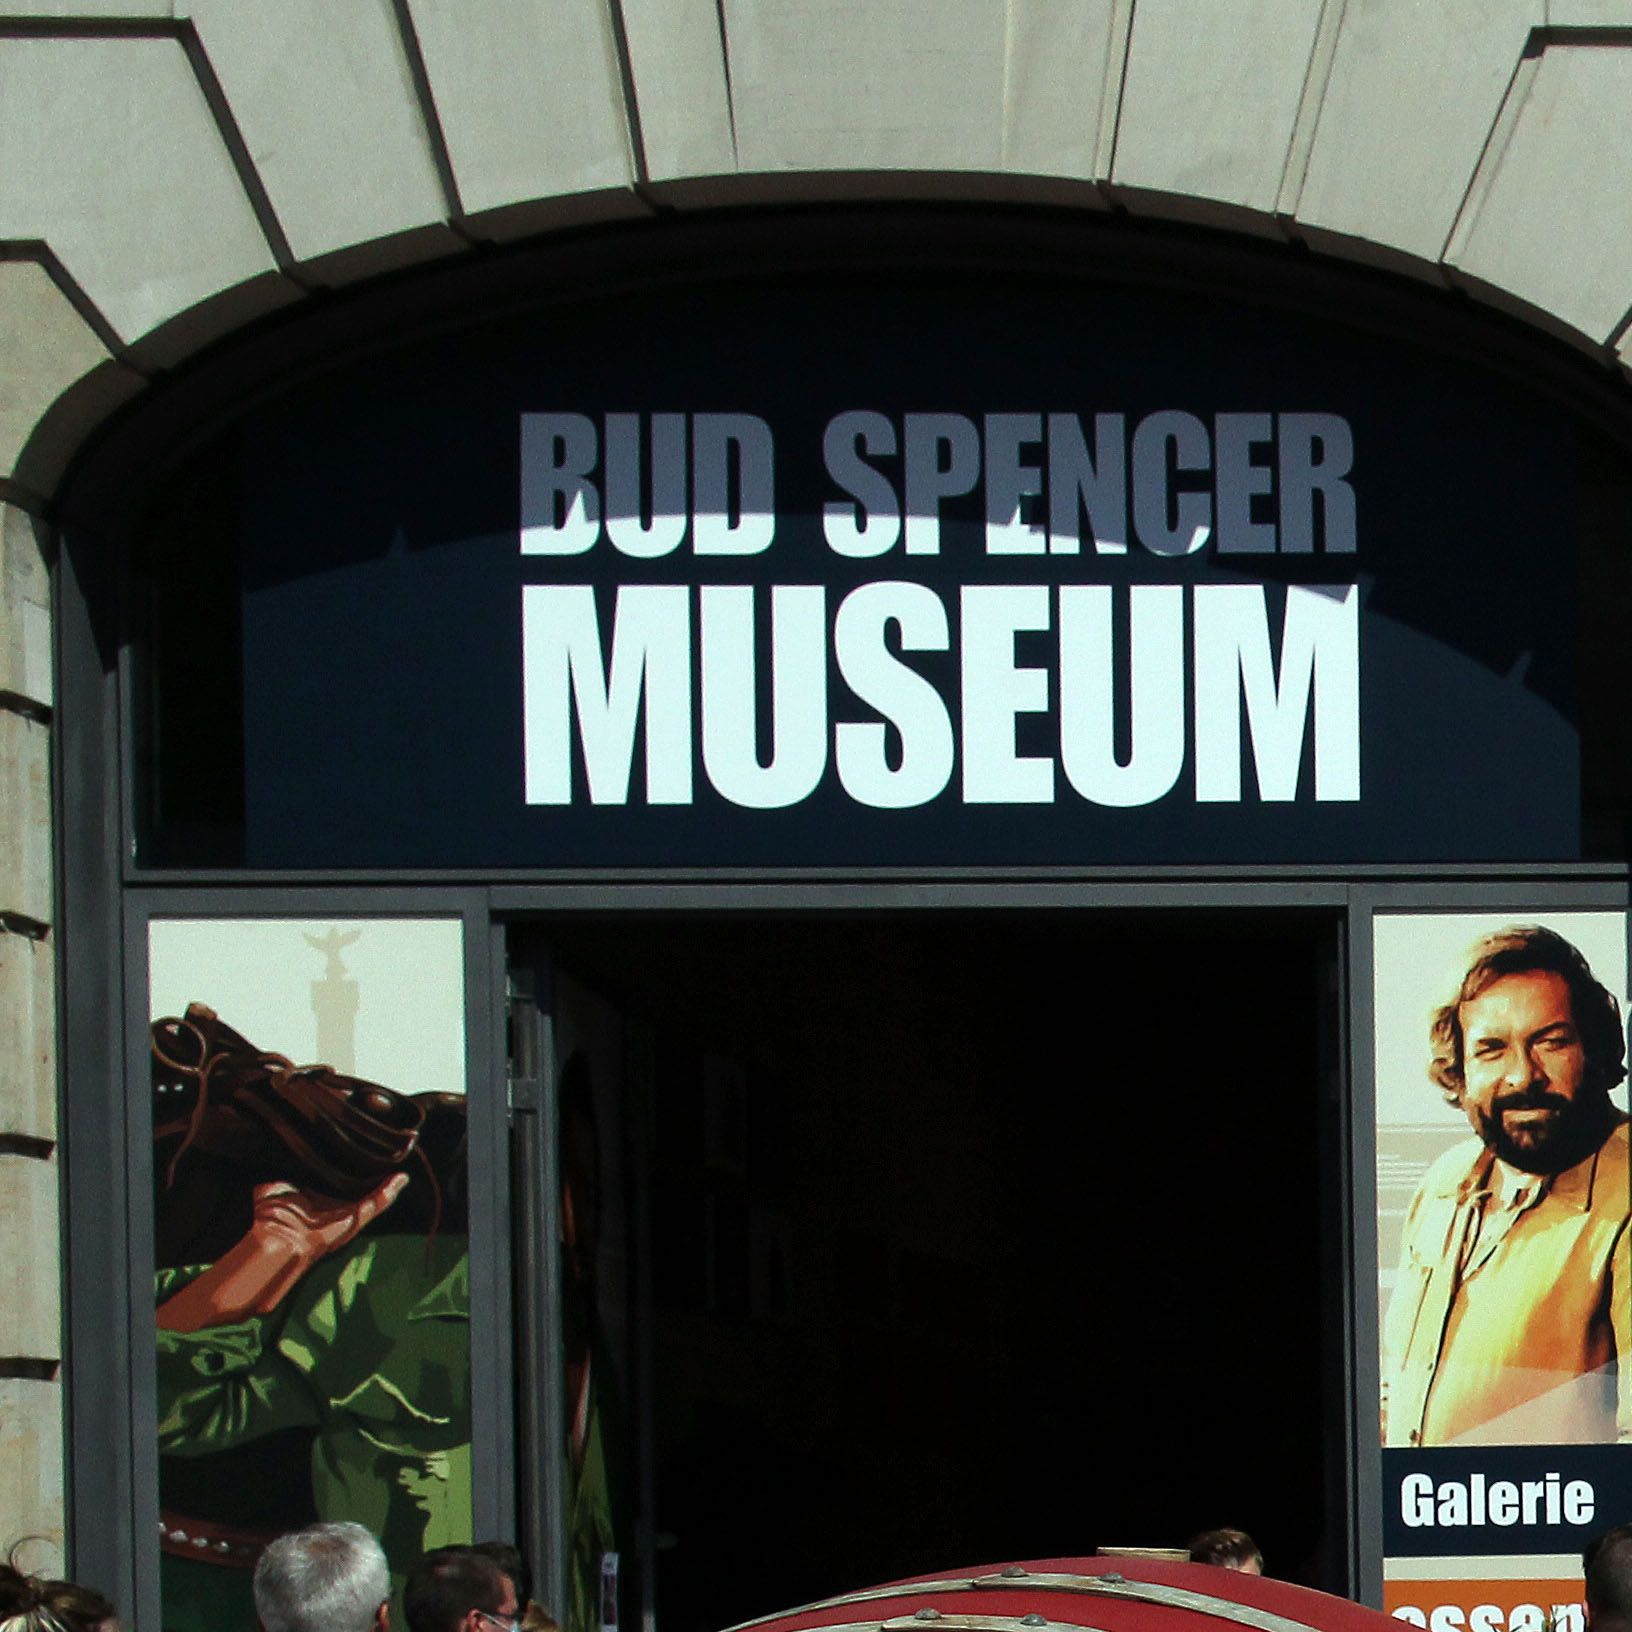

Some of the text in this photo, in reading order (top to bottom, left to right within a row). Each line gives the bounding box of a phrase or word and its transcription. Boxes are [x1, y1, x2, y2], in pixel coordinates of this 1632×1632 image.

[520, 410, 1357, 559] BUD SPENCER
[522, 581, 1360, 808] MUSEUM
[1402, 1473, 1595, 1528] Galerie
